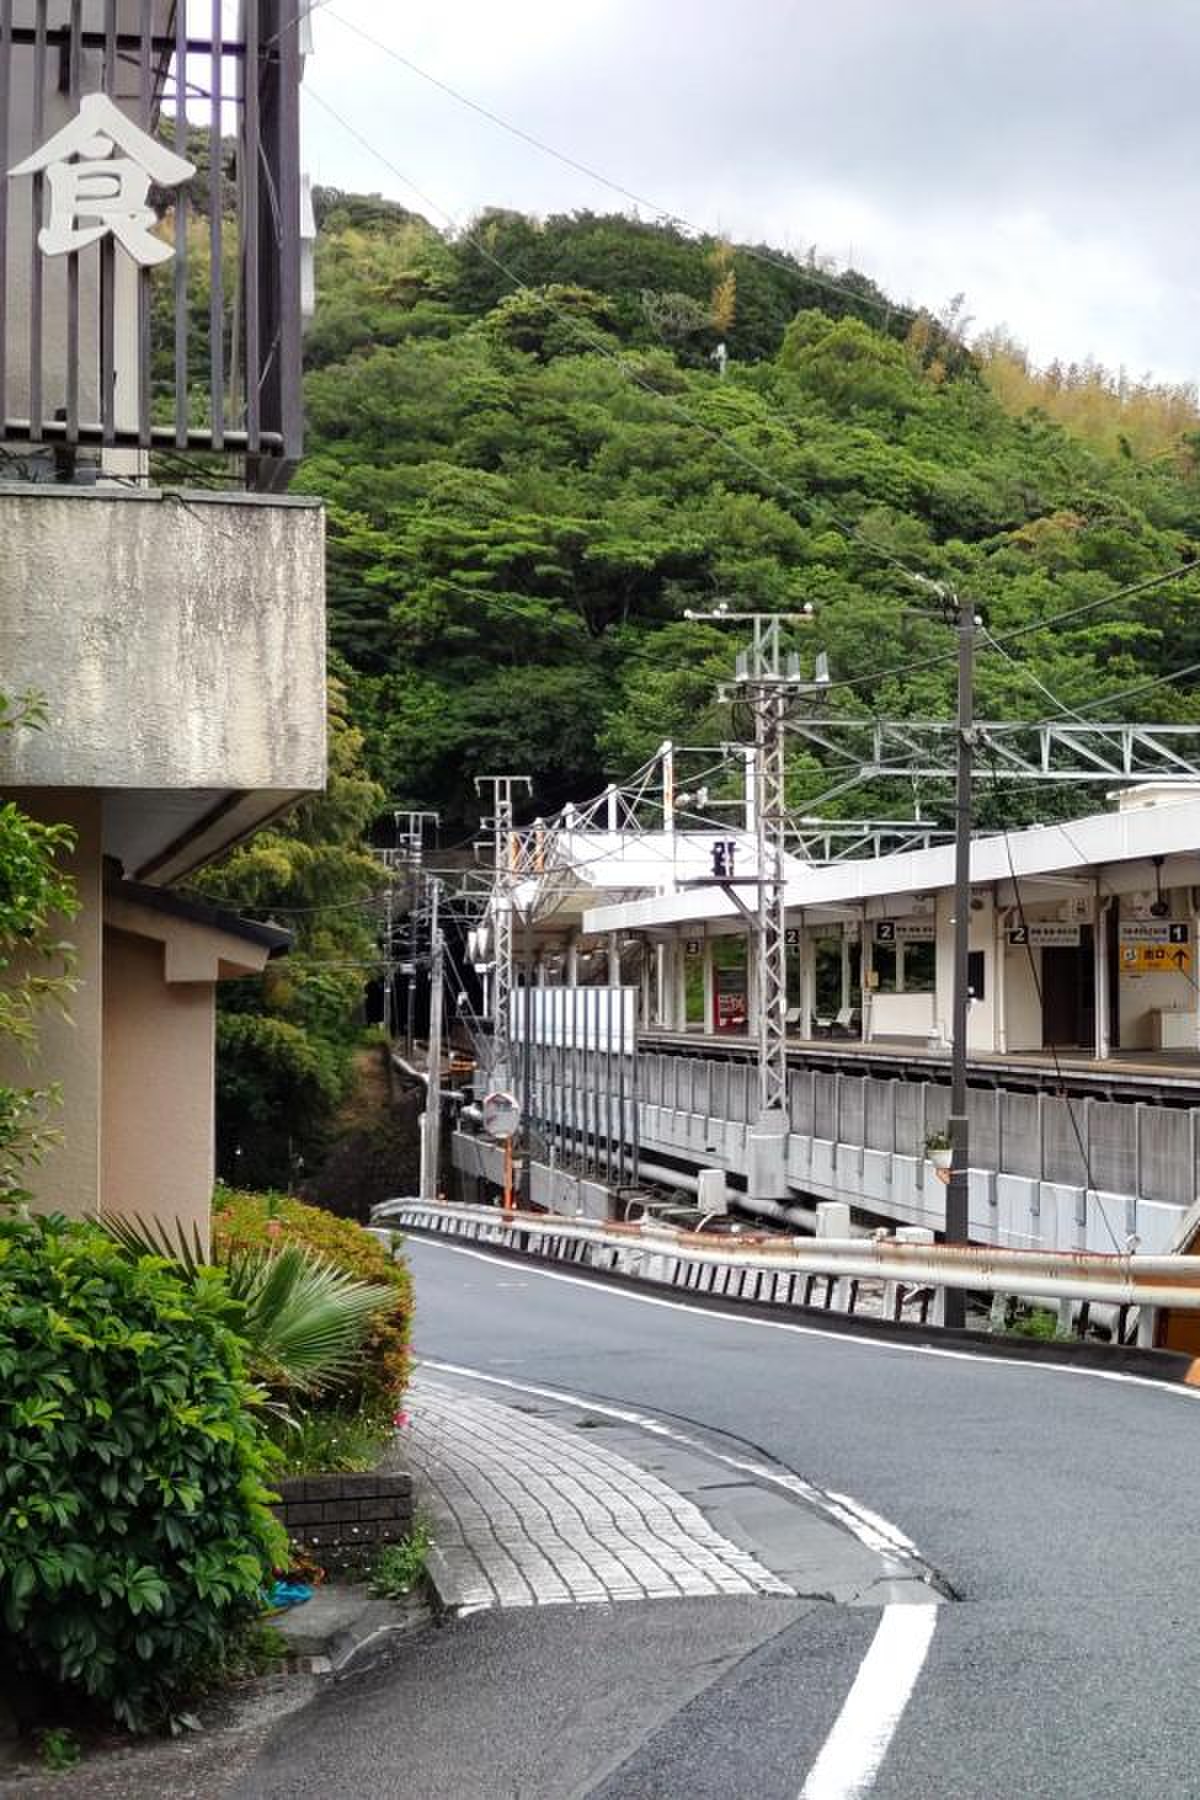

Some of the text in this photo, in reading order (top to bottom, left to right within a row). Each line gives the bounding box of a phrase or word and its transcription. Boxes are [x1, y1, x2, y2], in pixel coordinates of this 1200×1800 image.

[7, 92, 197, 267] 食
[787, 929, 797, 943] 2
[879, 924, 892, 939] 2
[1013, 927, 1025, 942] 2
